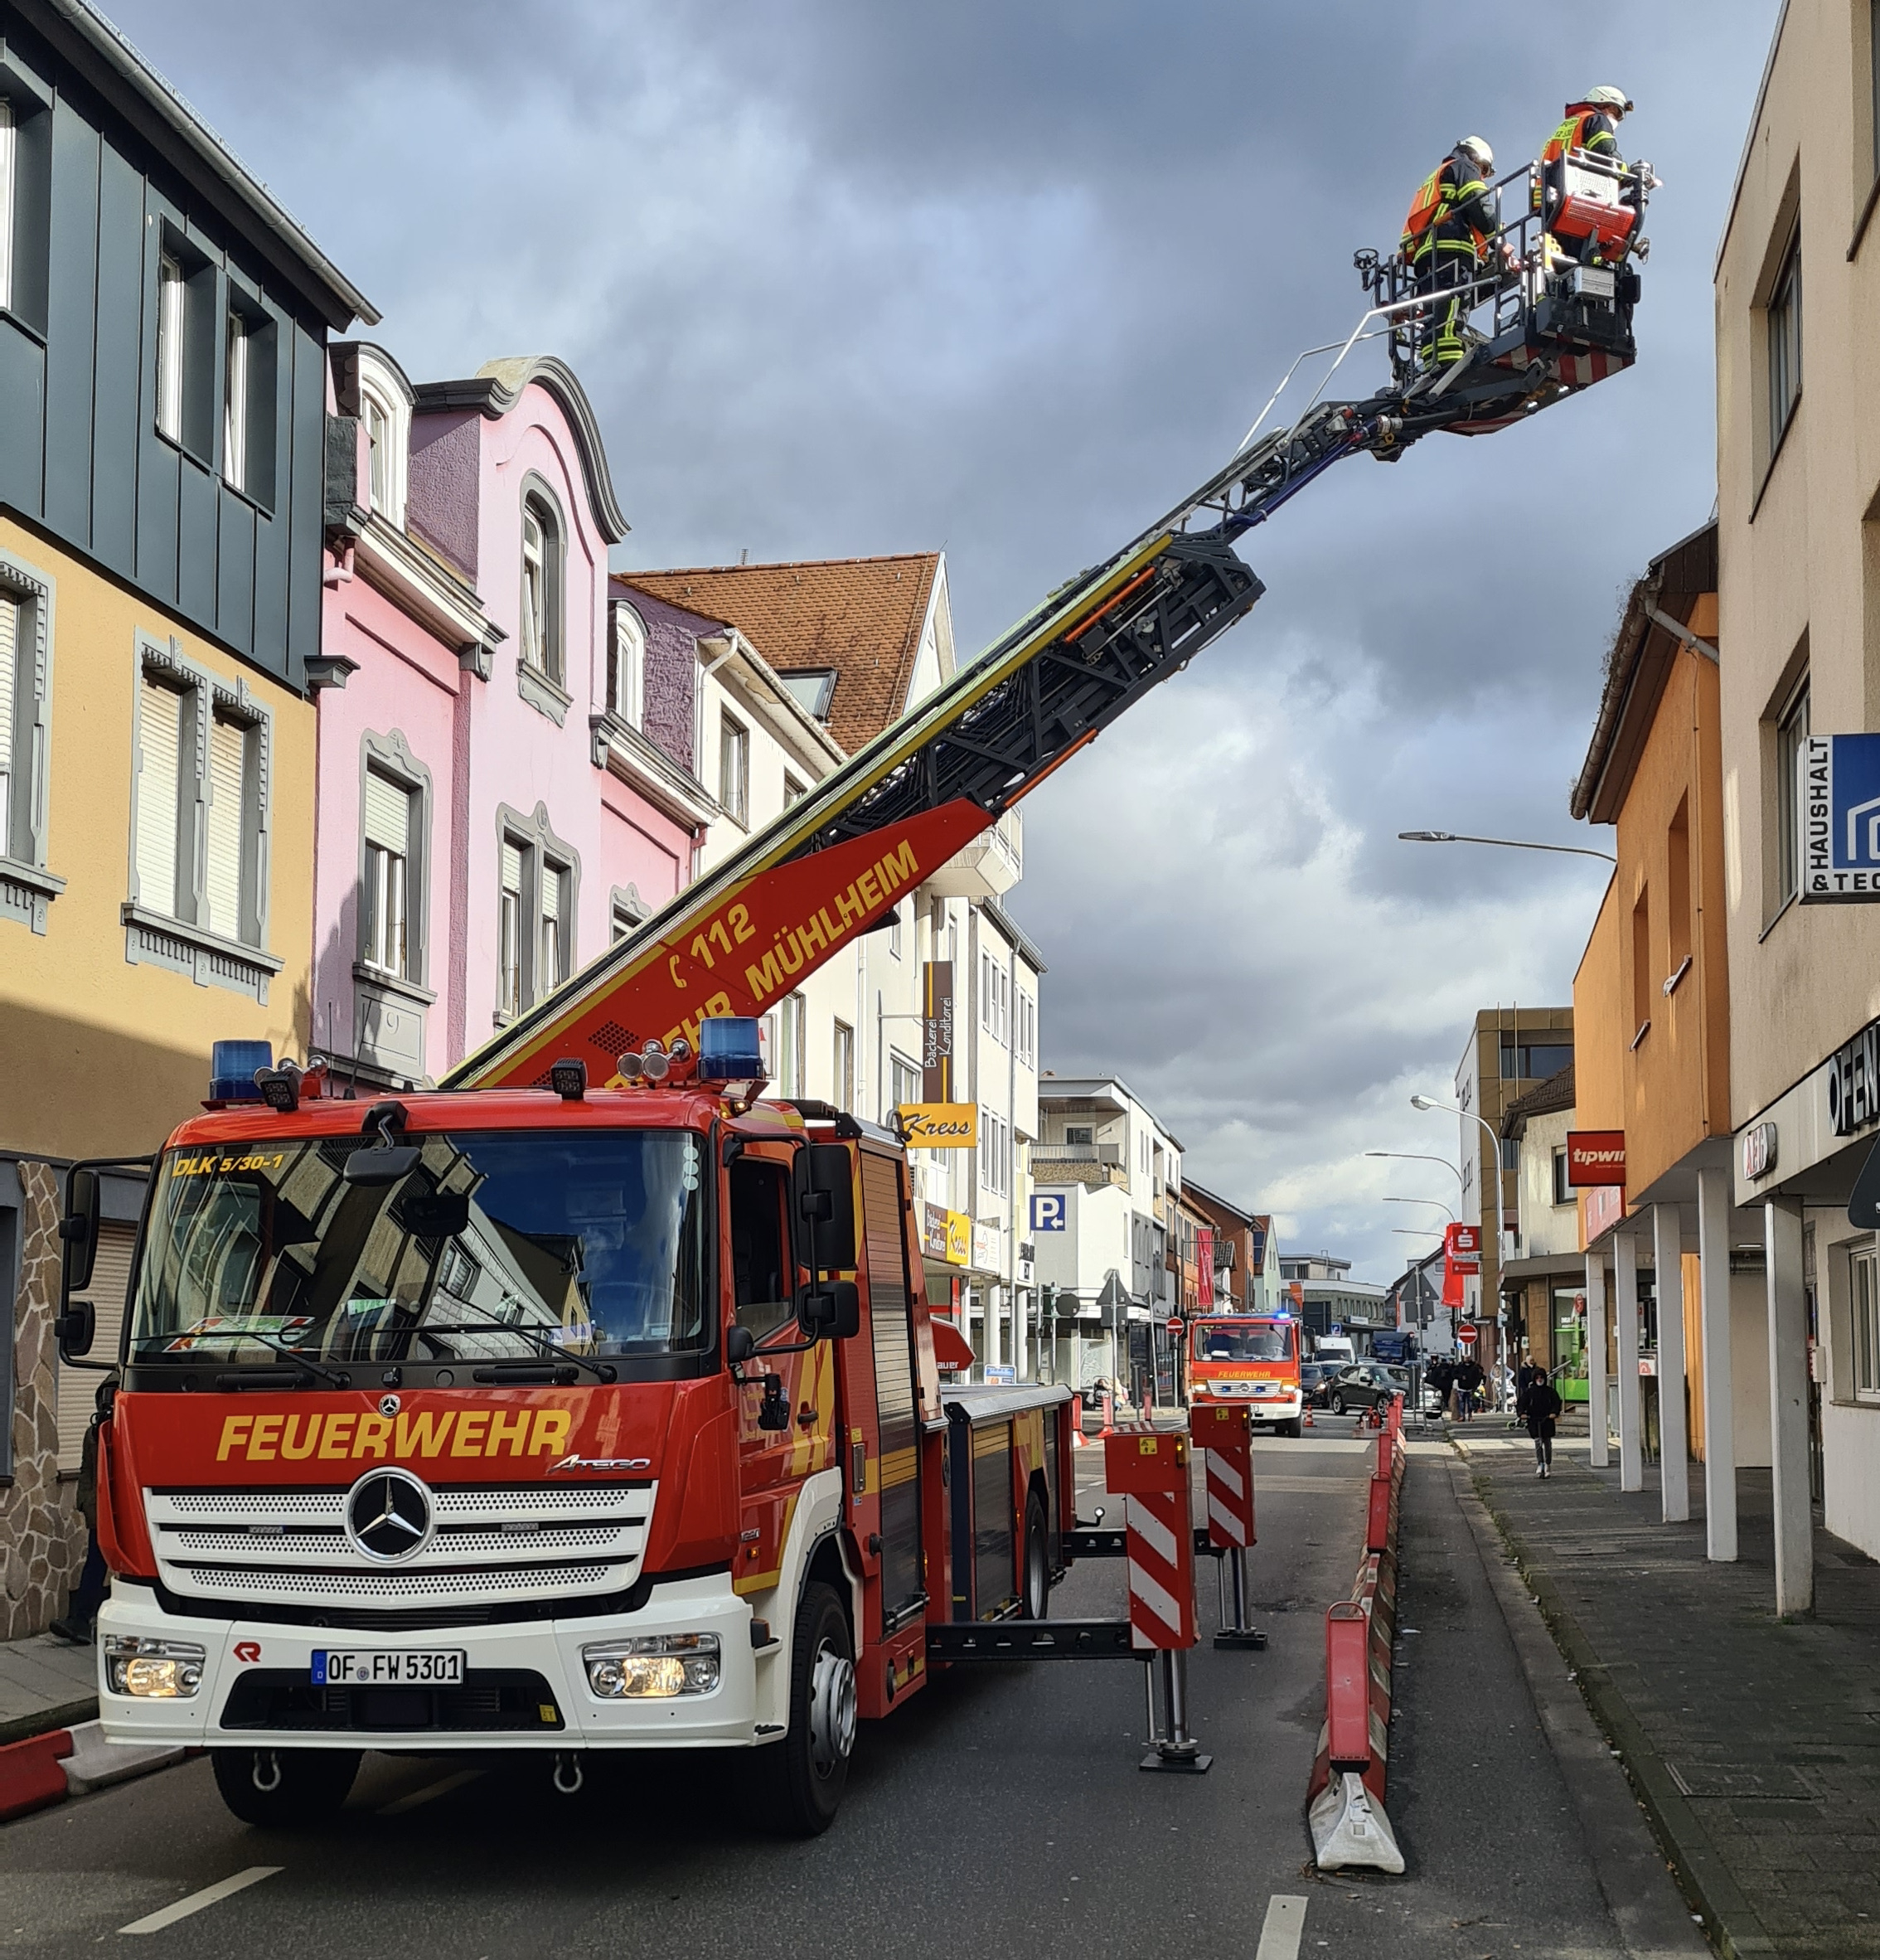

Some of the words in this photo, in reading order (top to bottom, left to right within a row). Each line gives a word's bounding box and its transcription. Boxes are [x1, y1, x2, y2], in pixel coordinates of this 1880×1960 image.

[1810, 739, 1829, 870] HAUSHALT
[1812, 874, 1830, 891] &
[690, 902, 757, 969] 112
[744, 838, 920, 1002] MÜHLHEIM
[924, 1018, 938, 1068] Bäckerei
[937, 997, 952, 1055] Konditorei
[904, 1113, 972, 1138] Kress
[172, 1155, 218, 1177] DLK
[219, 1154, 283, 1172] 5/30-1
[1745, 1126, 1766, 1177] AEG
[1036, 1197, 1059, 1227] P
[1218, 1371, 1272, 1379] FEUERWEHR
[216, 1409, 572, 1462] FEUERWEHR
[328, 1655, 356, 1681] OF
[373, 1655, 400, 1681] FW
[406, 1655, 459, 1681] 5301
